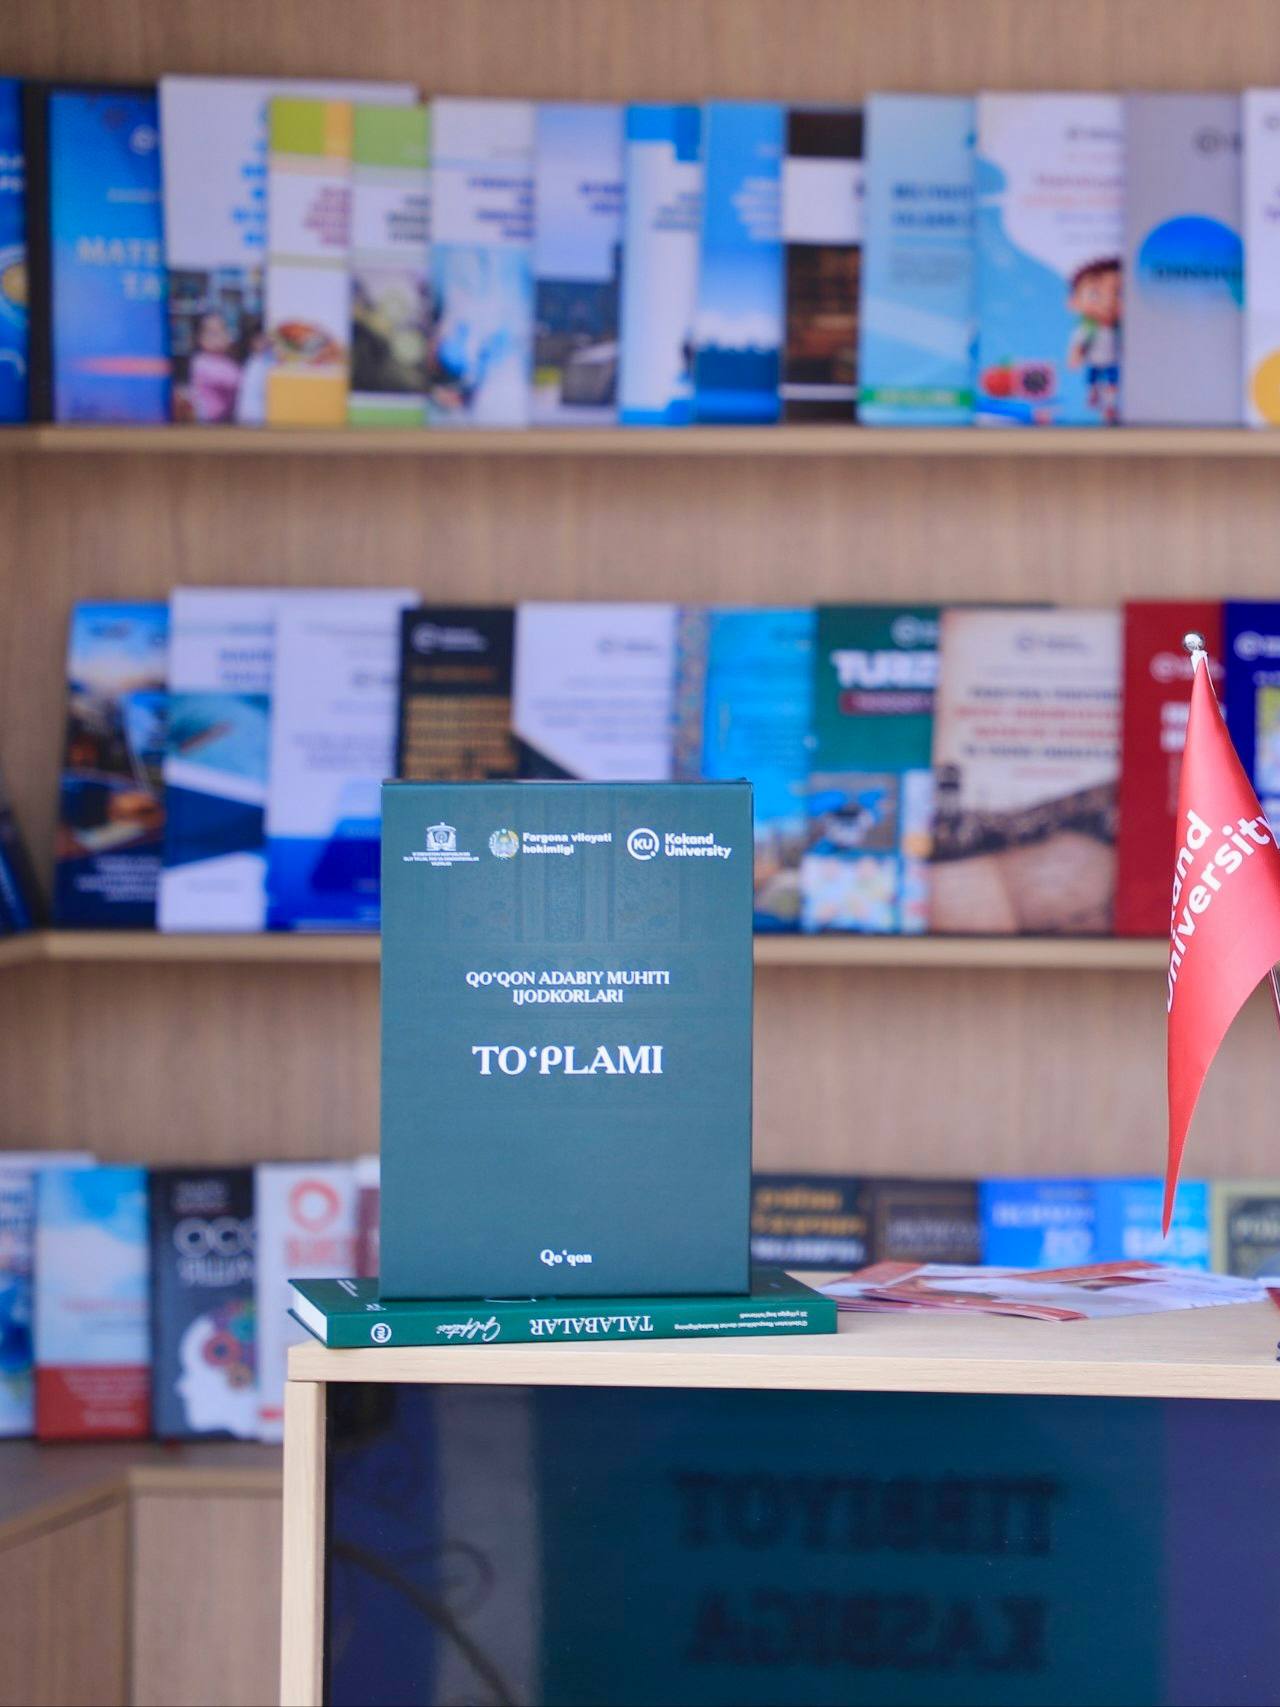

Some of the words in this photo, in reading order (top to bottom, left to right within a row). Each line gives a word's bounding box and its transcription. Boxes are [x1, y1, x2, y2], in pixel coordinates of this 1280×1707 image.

[665, 832, 714, 845] Kokand
[665, 844, 732, 859] University
[465, 970, 536, 988] QO‘QON
[539, 970, 605, 986] ADABIY
[607, 970, 671, 986] MUHITI
[513, 988, 624, 1005] IJODKORLARI
[471, 1044, 664, 1076] TO‘PLAMI
[540, 1248, 593, 1267] Qo‘qon
[530, 1315, 653, 1336] TALABALAR
